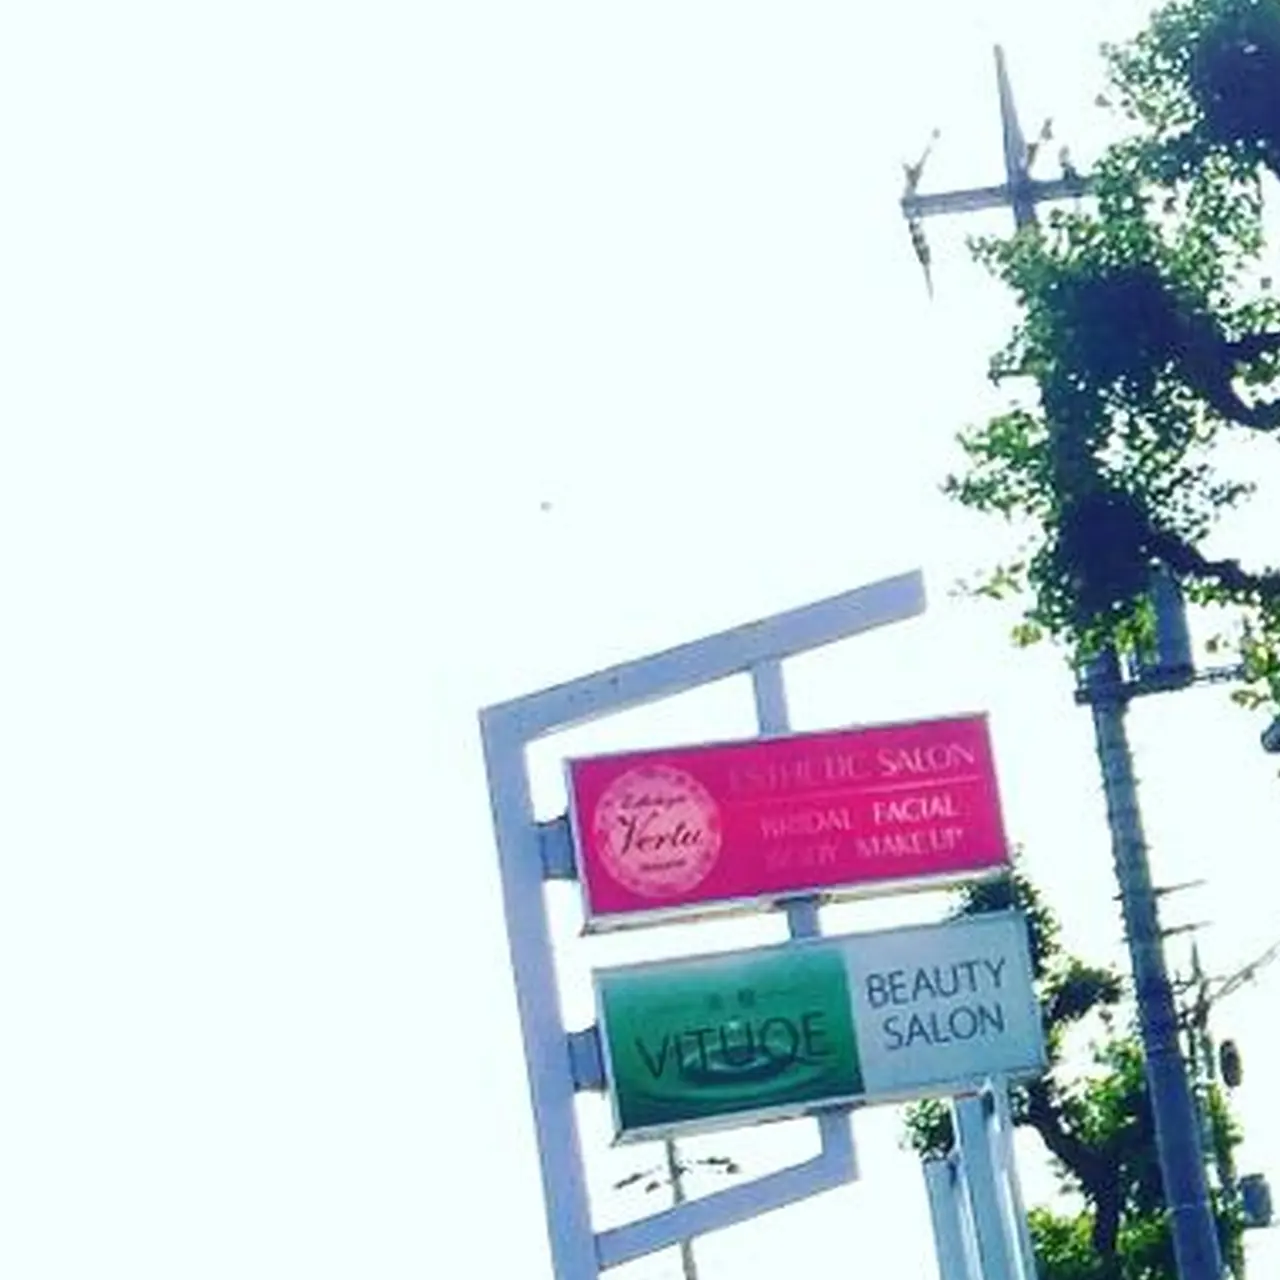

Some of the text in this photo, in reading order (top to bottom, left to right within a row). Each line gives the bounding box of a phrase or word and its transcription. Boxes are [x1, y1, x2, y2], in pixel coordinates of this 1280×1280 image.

[877, 742, 976, 777] SALON
[873, 794, 957, 827] FACIAL
[866, 959, 1006, 1008] BEAUTY
[883, 1006, 1006, 1051] SALON
